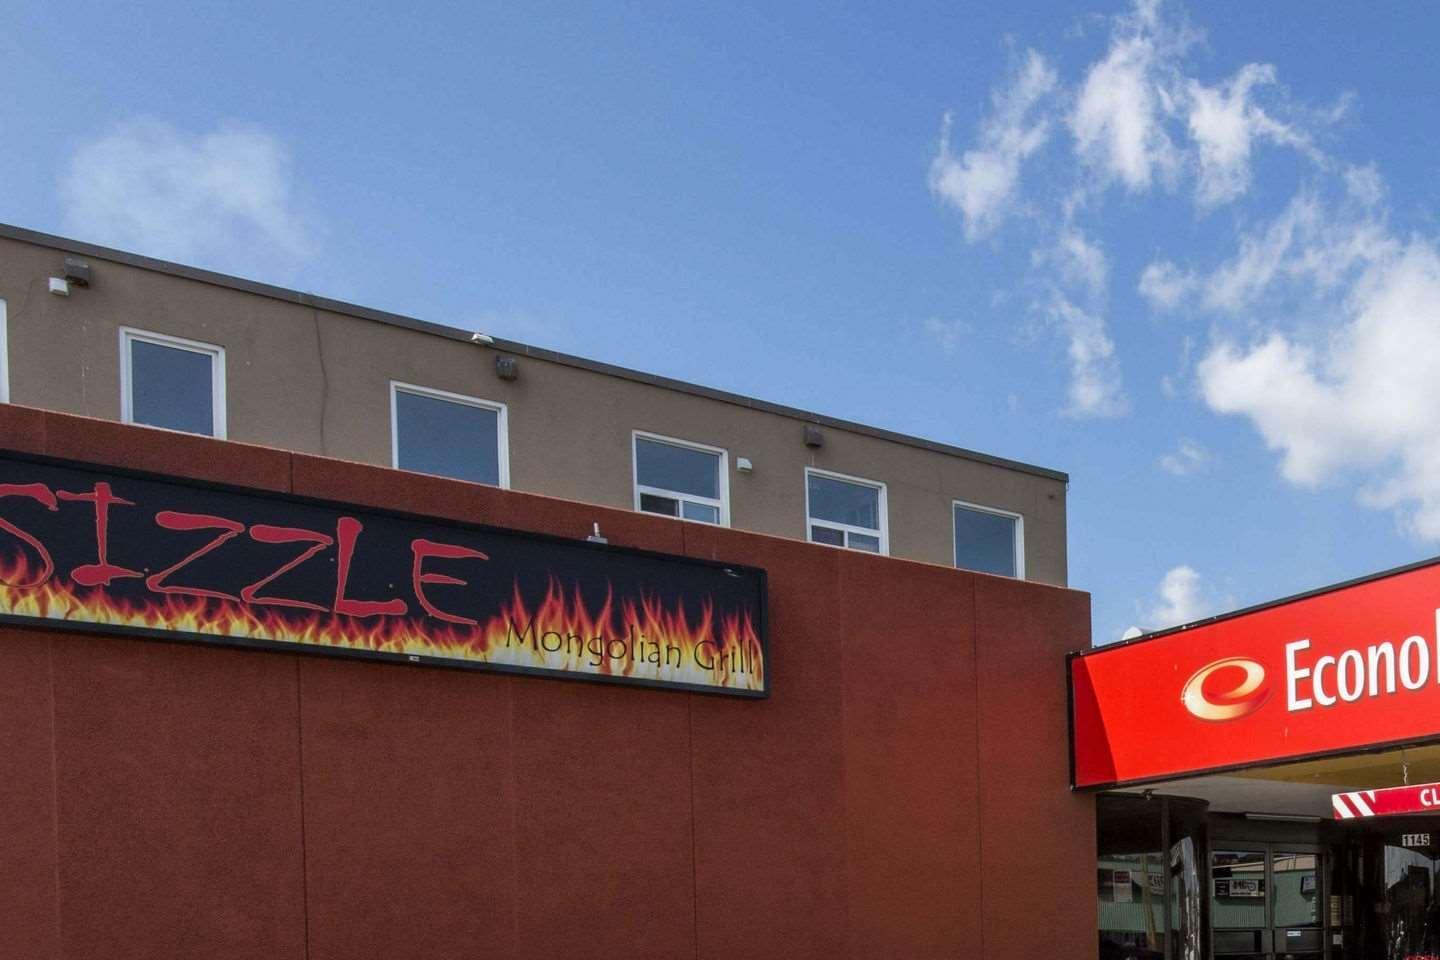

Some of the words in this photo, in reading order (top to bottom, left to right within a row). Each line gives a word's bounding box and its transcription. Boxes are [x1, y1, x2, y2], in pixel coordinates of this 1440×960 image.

[0, 482, 489, 626] SIZZLE
[505, 615, 682, 669] Mongolian
[694, 638, 754, 674] Grill
[1402, 834, 1430, 847] 1145
